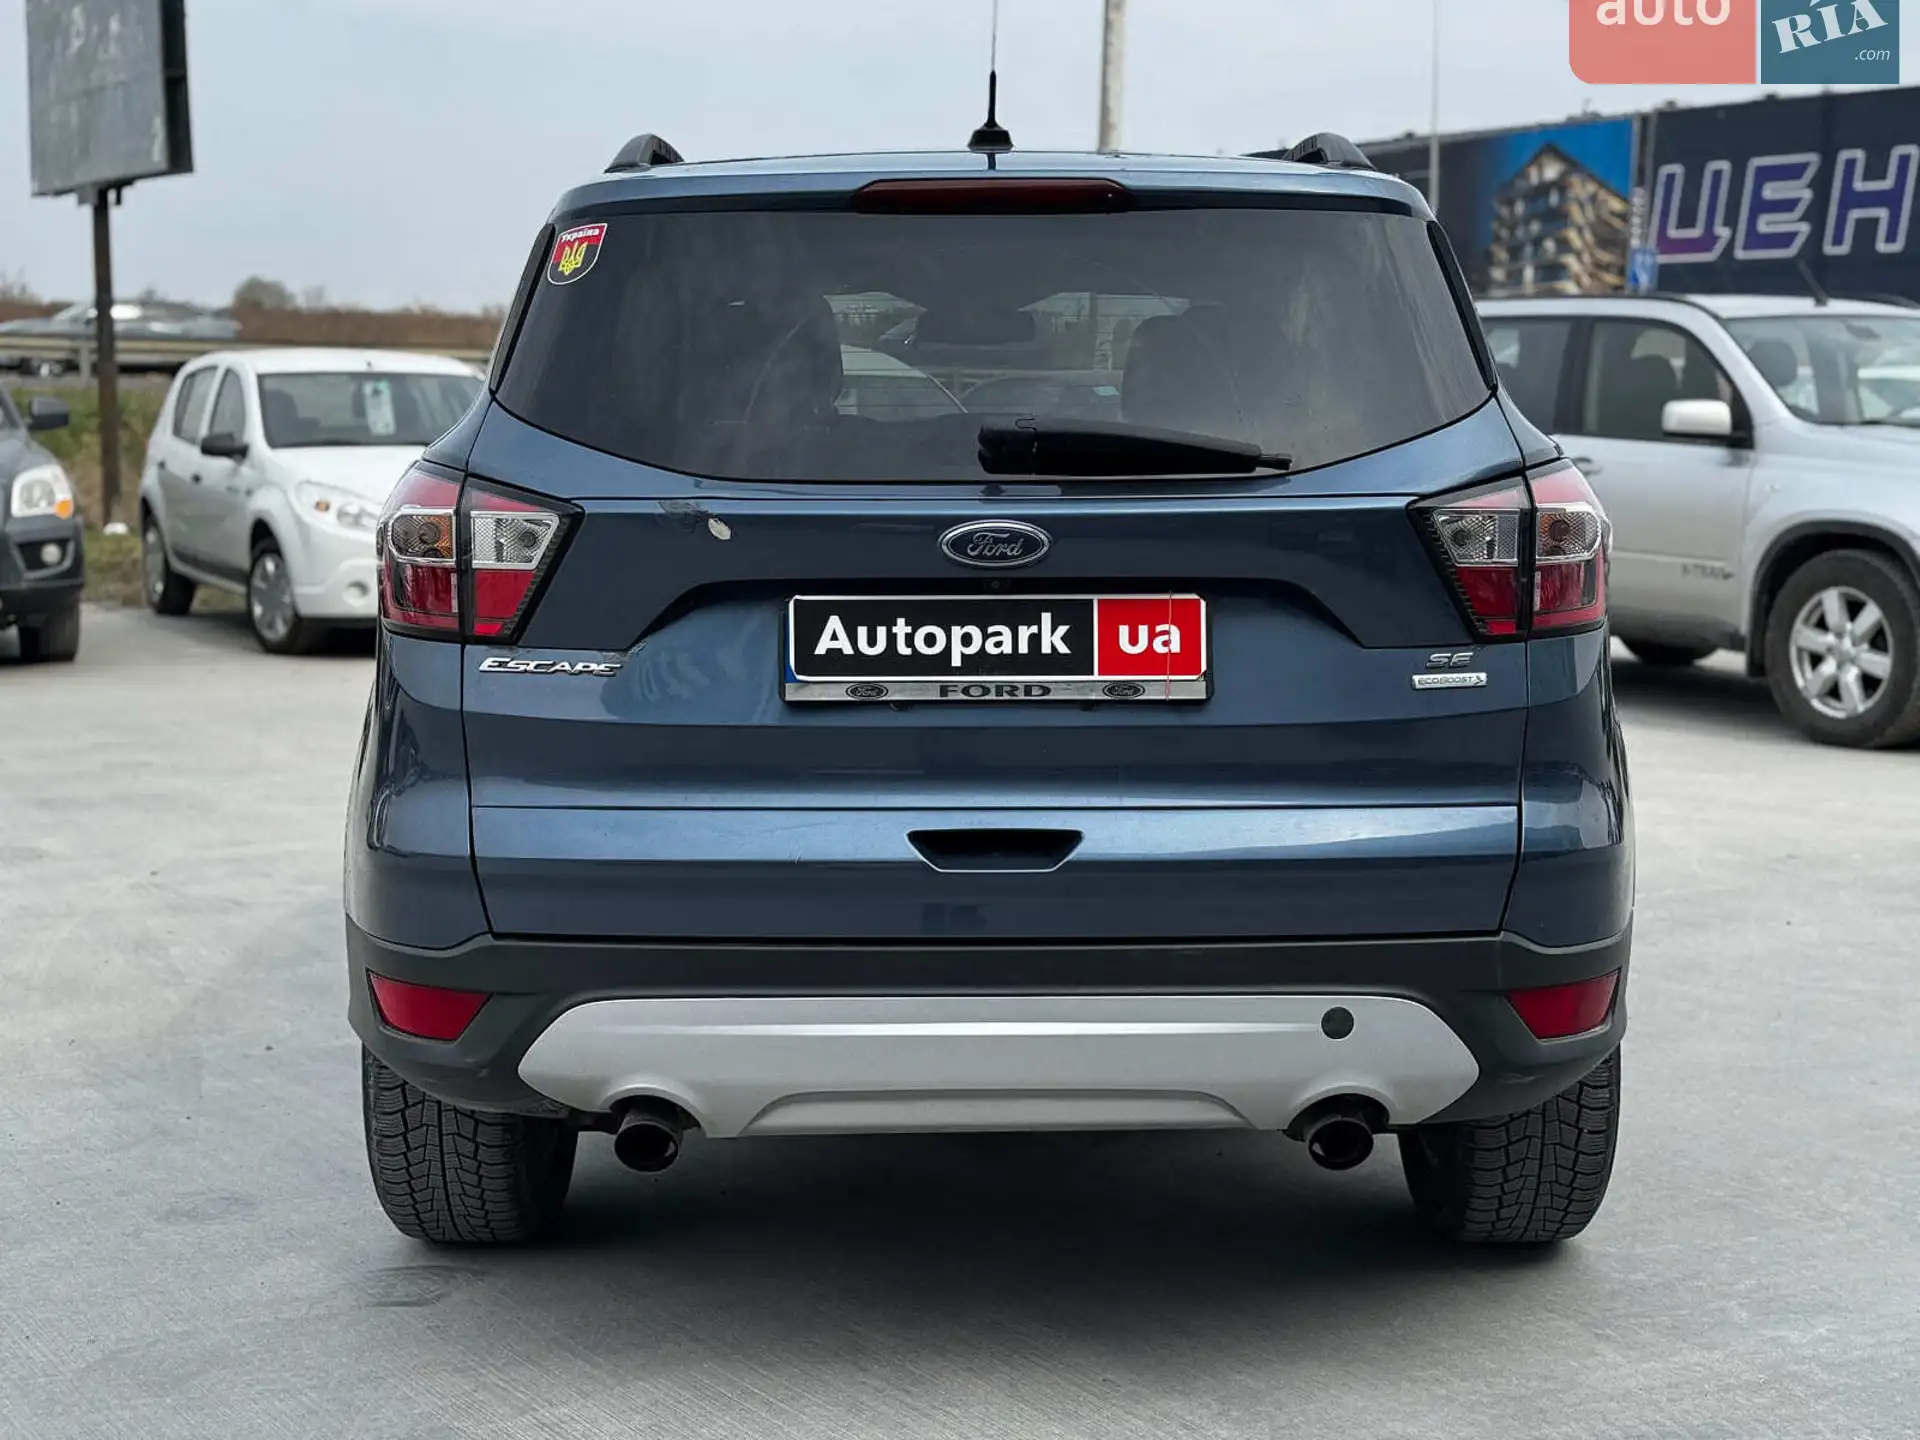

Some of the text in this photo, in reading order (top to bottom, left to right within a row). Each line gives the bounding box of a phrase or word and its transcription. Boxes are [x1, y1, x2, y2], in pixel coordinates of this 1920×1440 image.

[967, 532, 1024, 556] Ford
[814, 612, 1181, 667] Autopark ua
[1426, 652, 1474, 668] SE
[939, 684, 1051, 698] FORD
